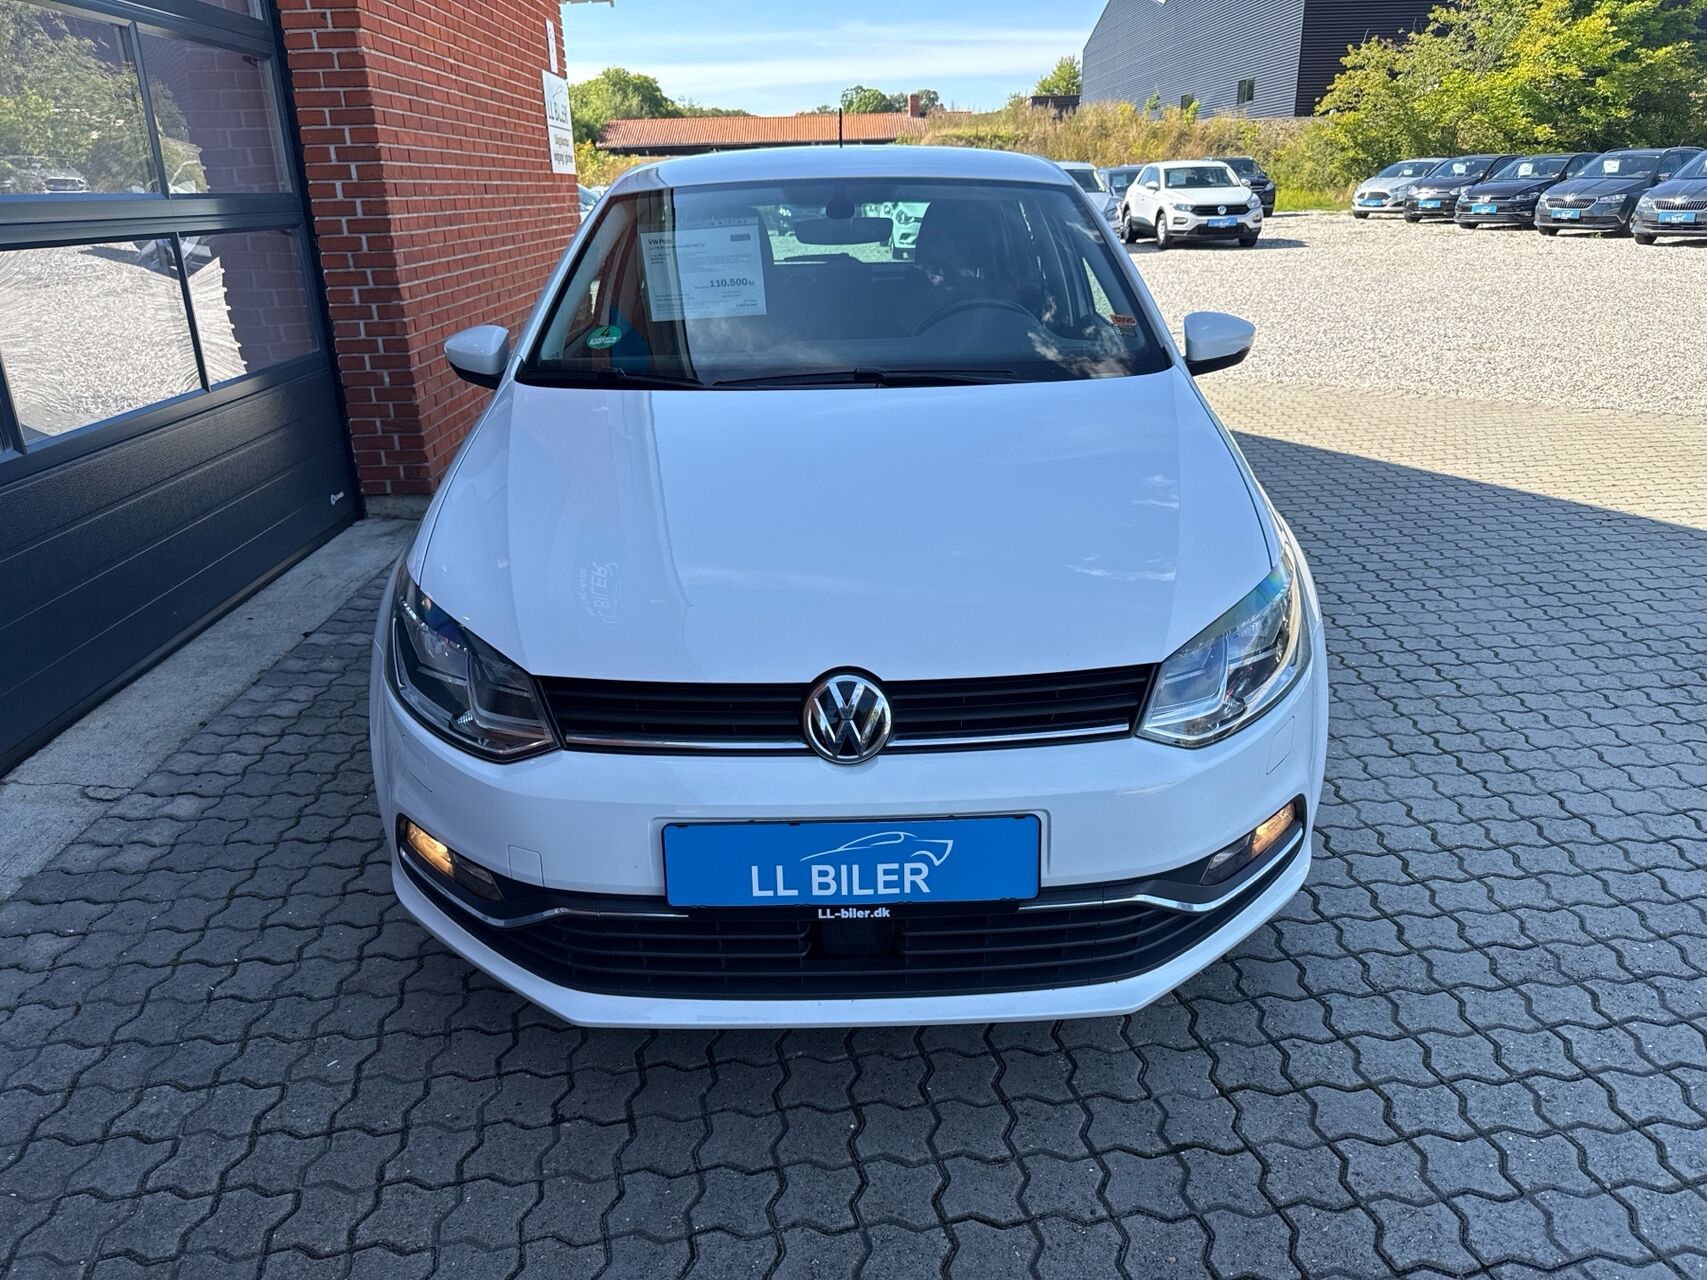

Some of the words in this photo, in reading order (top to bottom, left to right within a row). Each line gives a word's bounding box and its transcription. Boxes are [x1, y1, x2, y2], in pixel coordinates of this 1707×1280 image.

[709, 277, 748, 288] 110.500
[600, 326, 610, 337] 4
[751, 864, 799, 897] LL
[810, 862, 931, 897] BILER
[818, 907, 891, 919] LL-biler.dk
